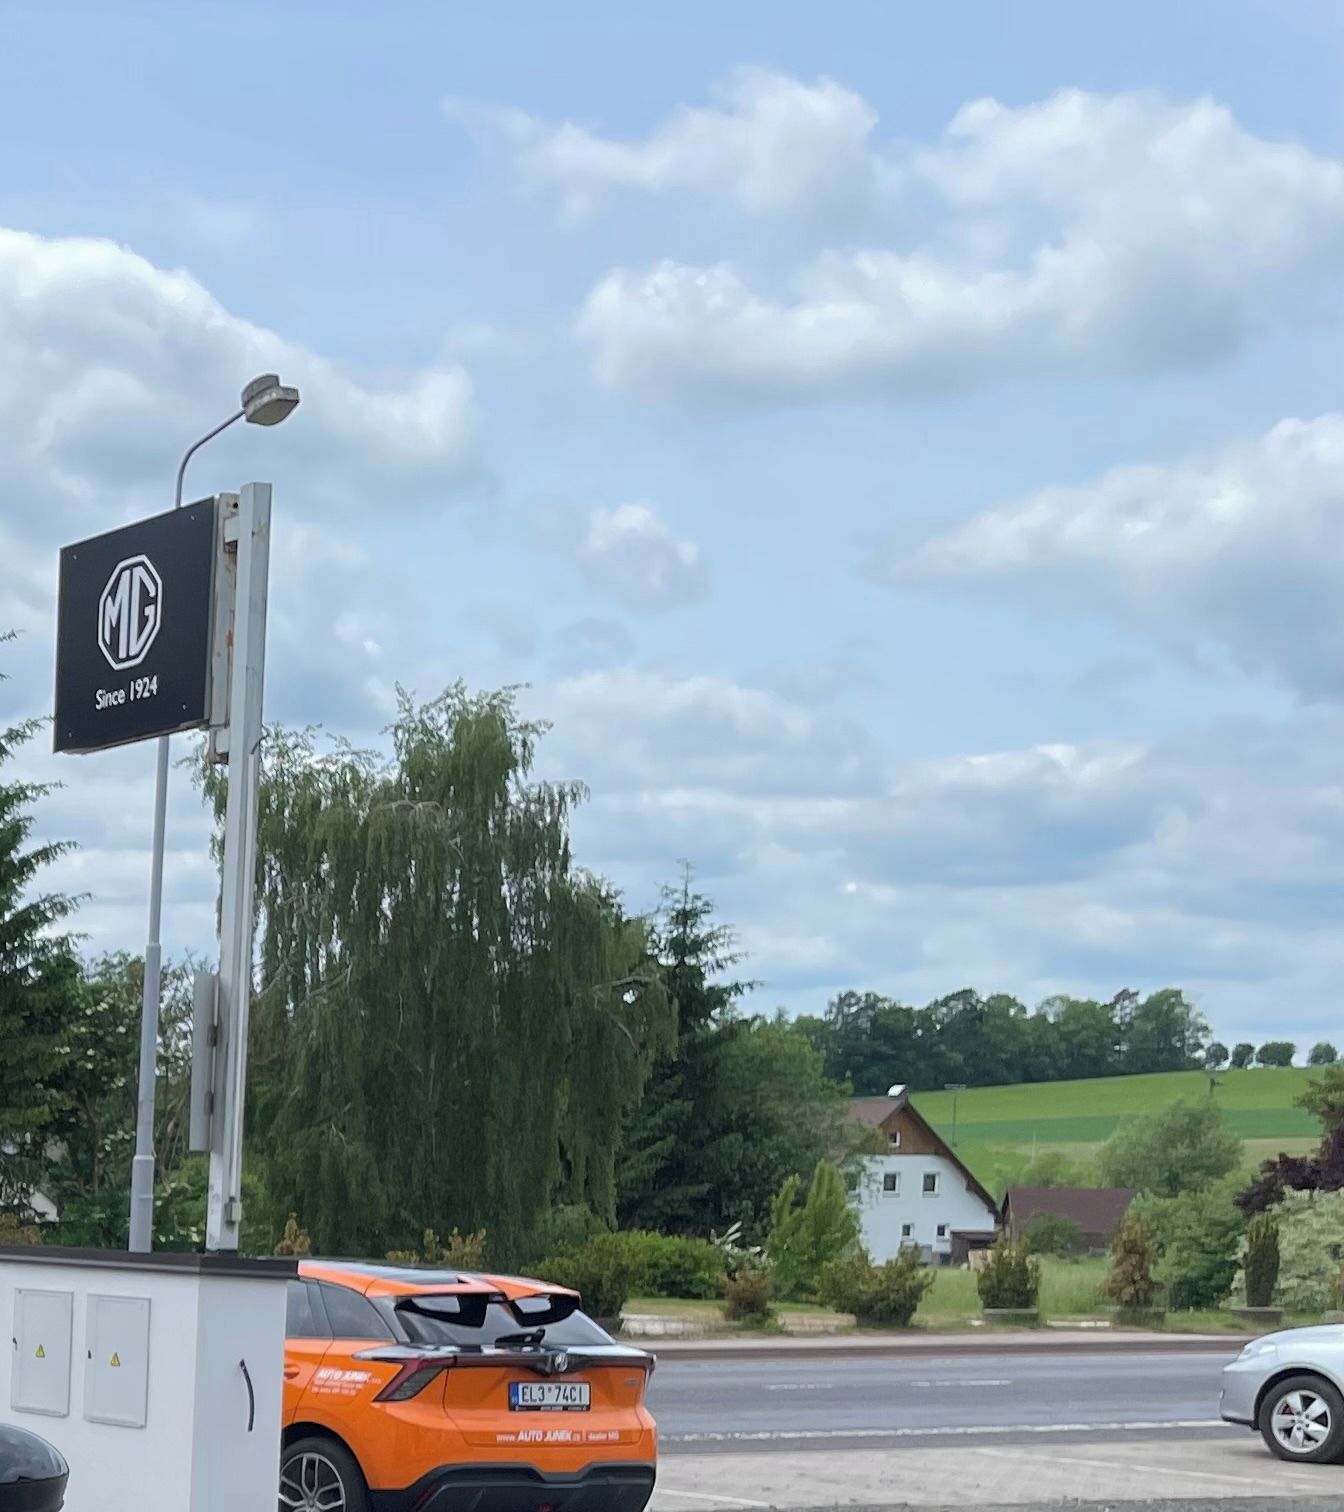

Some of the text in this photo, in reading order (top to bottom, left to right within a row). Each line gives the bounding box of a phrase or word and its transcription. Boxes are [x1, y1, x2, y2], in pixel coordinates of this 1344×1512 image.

[103, 565, 157, 660] MG
[95, 675, 158, 711] Since 1924
